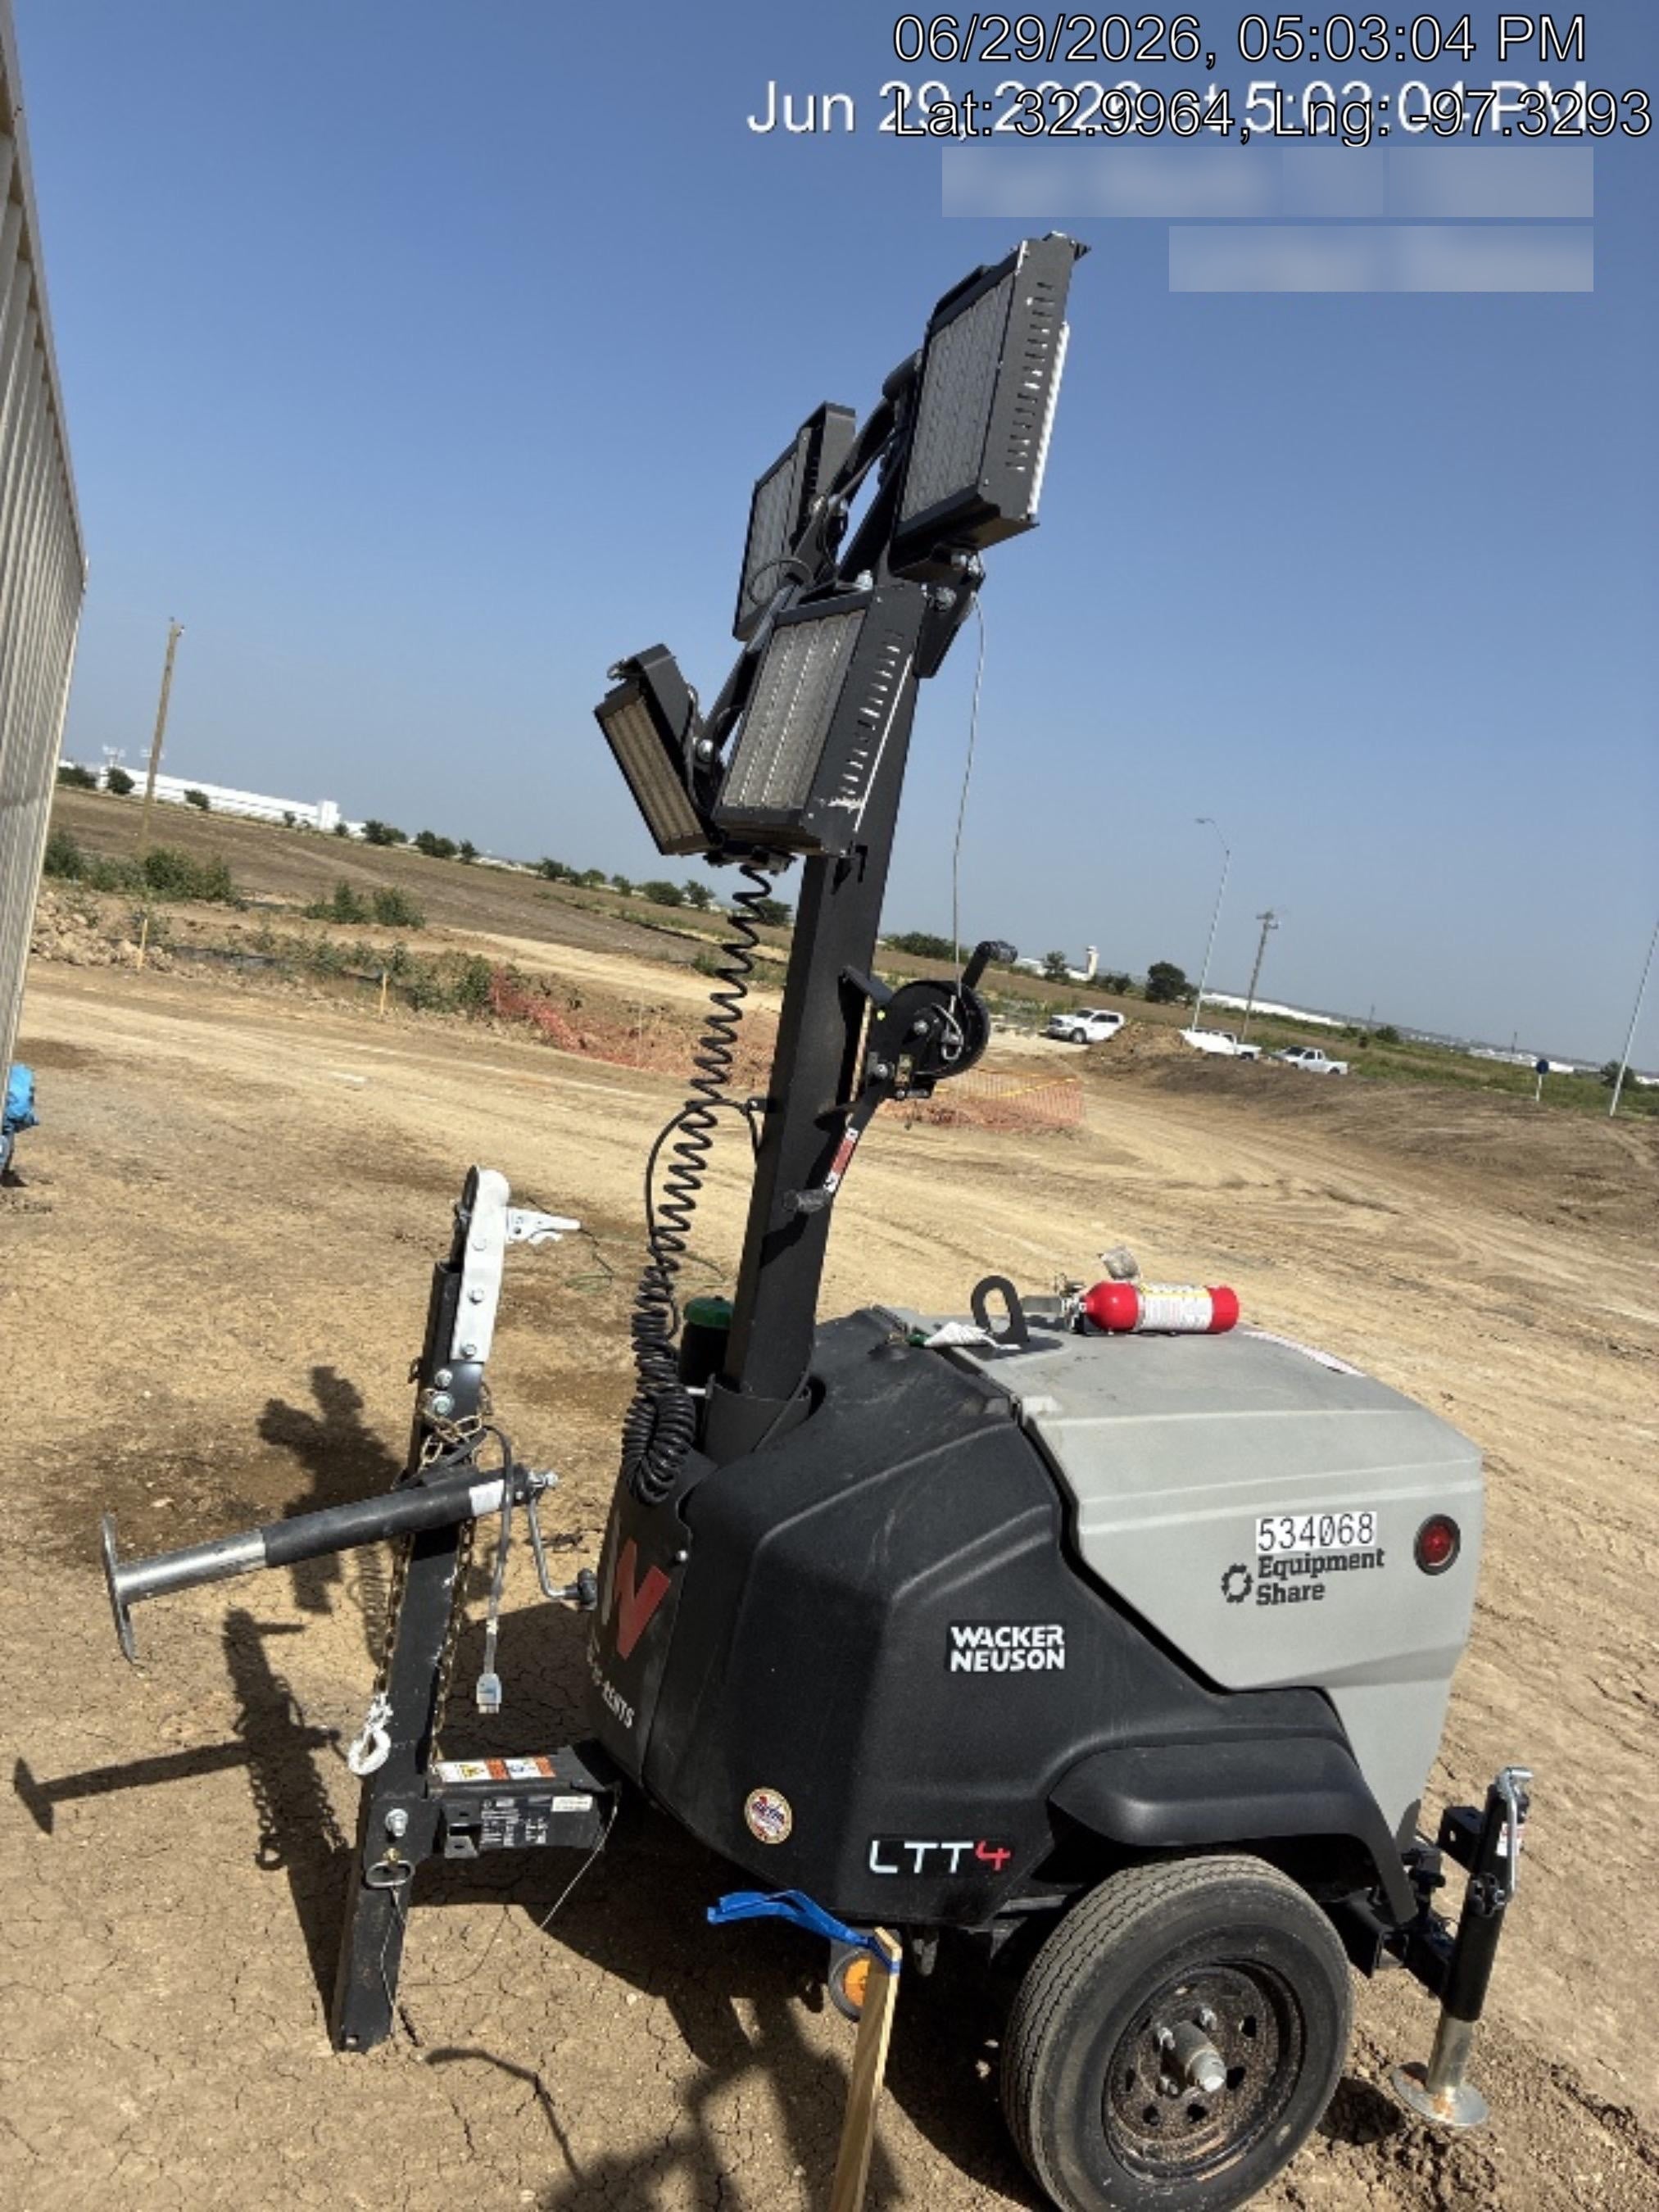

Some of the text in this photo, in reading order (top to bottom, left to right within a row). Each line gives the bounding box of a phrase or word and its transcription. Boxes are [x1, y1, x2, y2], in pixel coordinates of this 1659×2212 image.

[1258, 1512, 1374, 1552] 534068
[1257, 1548, 1386, 1581] Equipment
[1255, 1582, 1326, 1606] Share
[950, 1624, 1065, 1648] WACKER
[950, 1648, 1066, 1673] NEUSON
[868, 1839, 1012, 1874] LTT4
